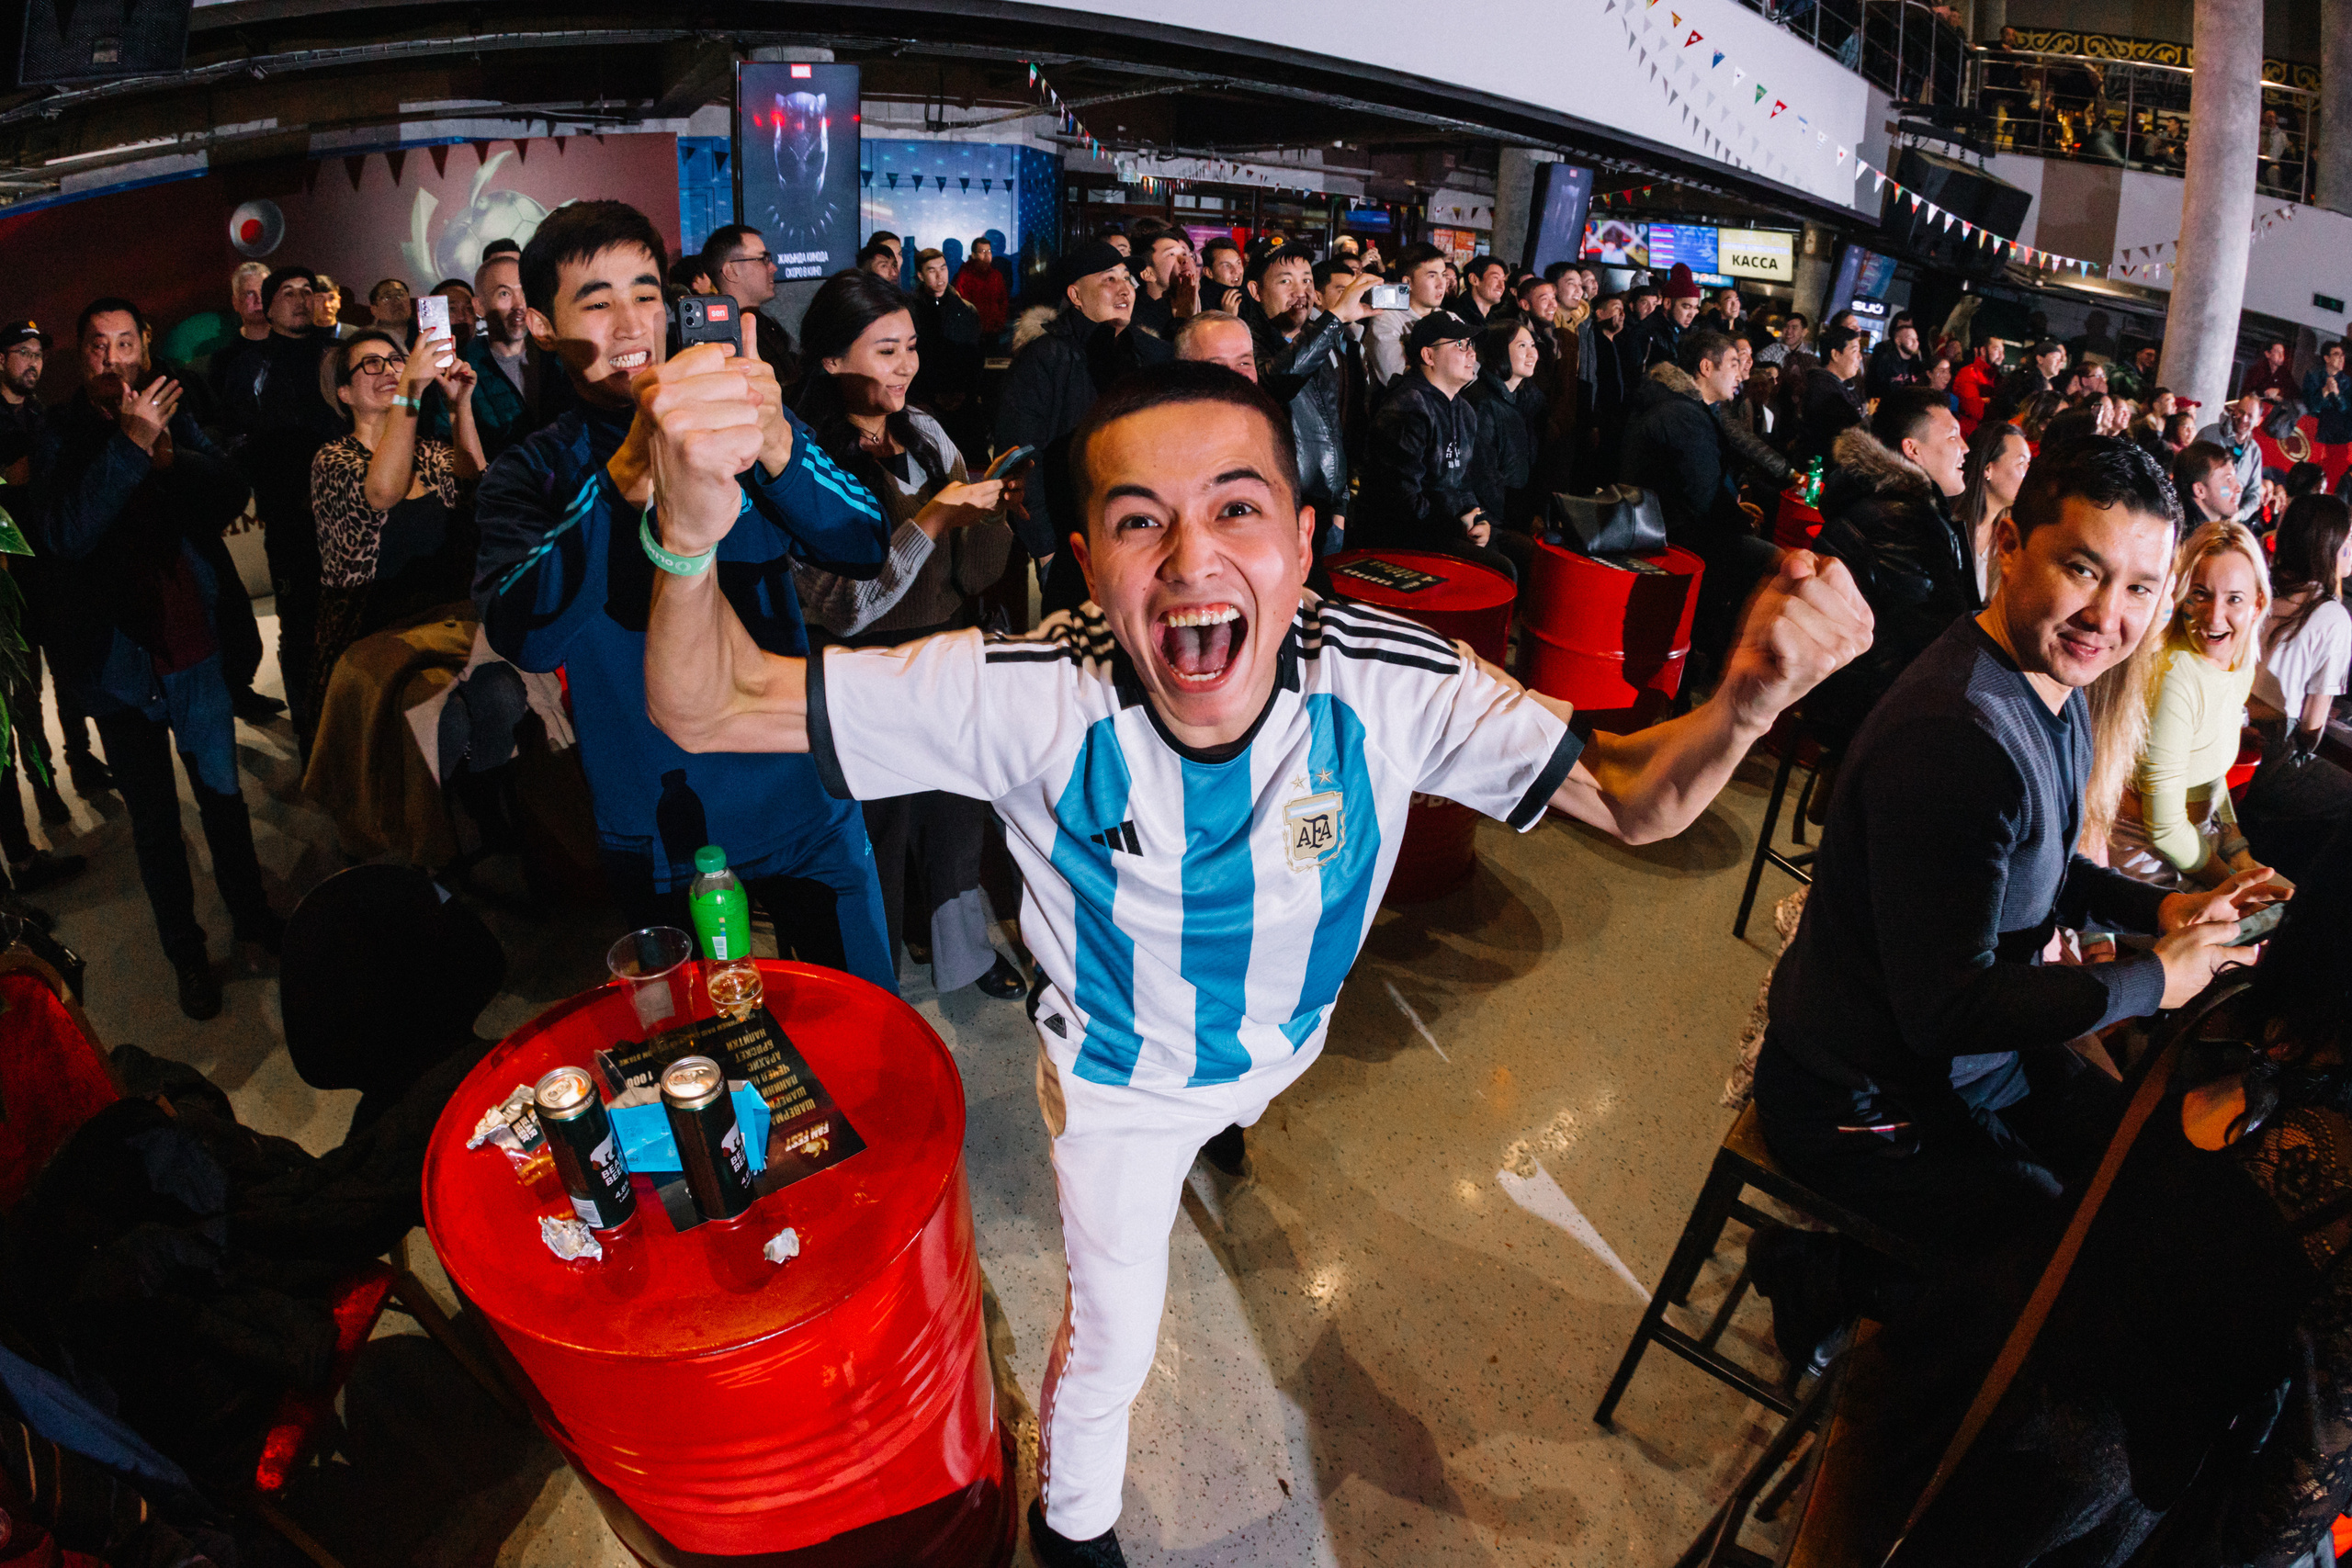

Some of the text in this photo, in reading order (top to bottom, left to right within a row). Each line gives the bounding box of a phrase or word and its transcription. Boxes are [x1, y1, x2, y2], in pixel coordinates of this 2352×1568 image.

[807, 265, 822, 276] КИНО
[1732, 254, 1778, 270] КАССА
[1296, 814, 1332, 849] AFA
[726, 1029, 767, 1051] НАПИТКИ
[735, 1039, 774, 1064] БРИСКЕТ
[746, 1050, 781, 1073] АРАХИС
[761, 1064, 790, 1083] ЧЕЧЕЛ
[761, 1074, 798, 1098] ПАНИНИ
[766, 1086, 807, 1110] ШАВЕРМ
[772, 1098, 816, 1126] ШАВЕРМА
[512, 1122, 531, 1143] BEER
[519, 1116, 538, 1138] BEAR
[785, 1121, 830, 1152] FAN FEST
